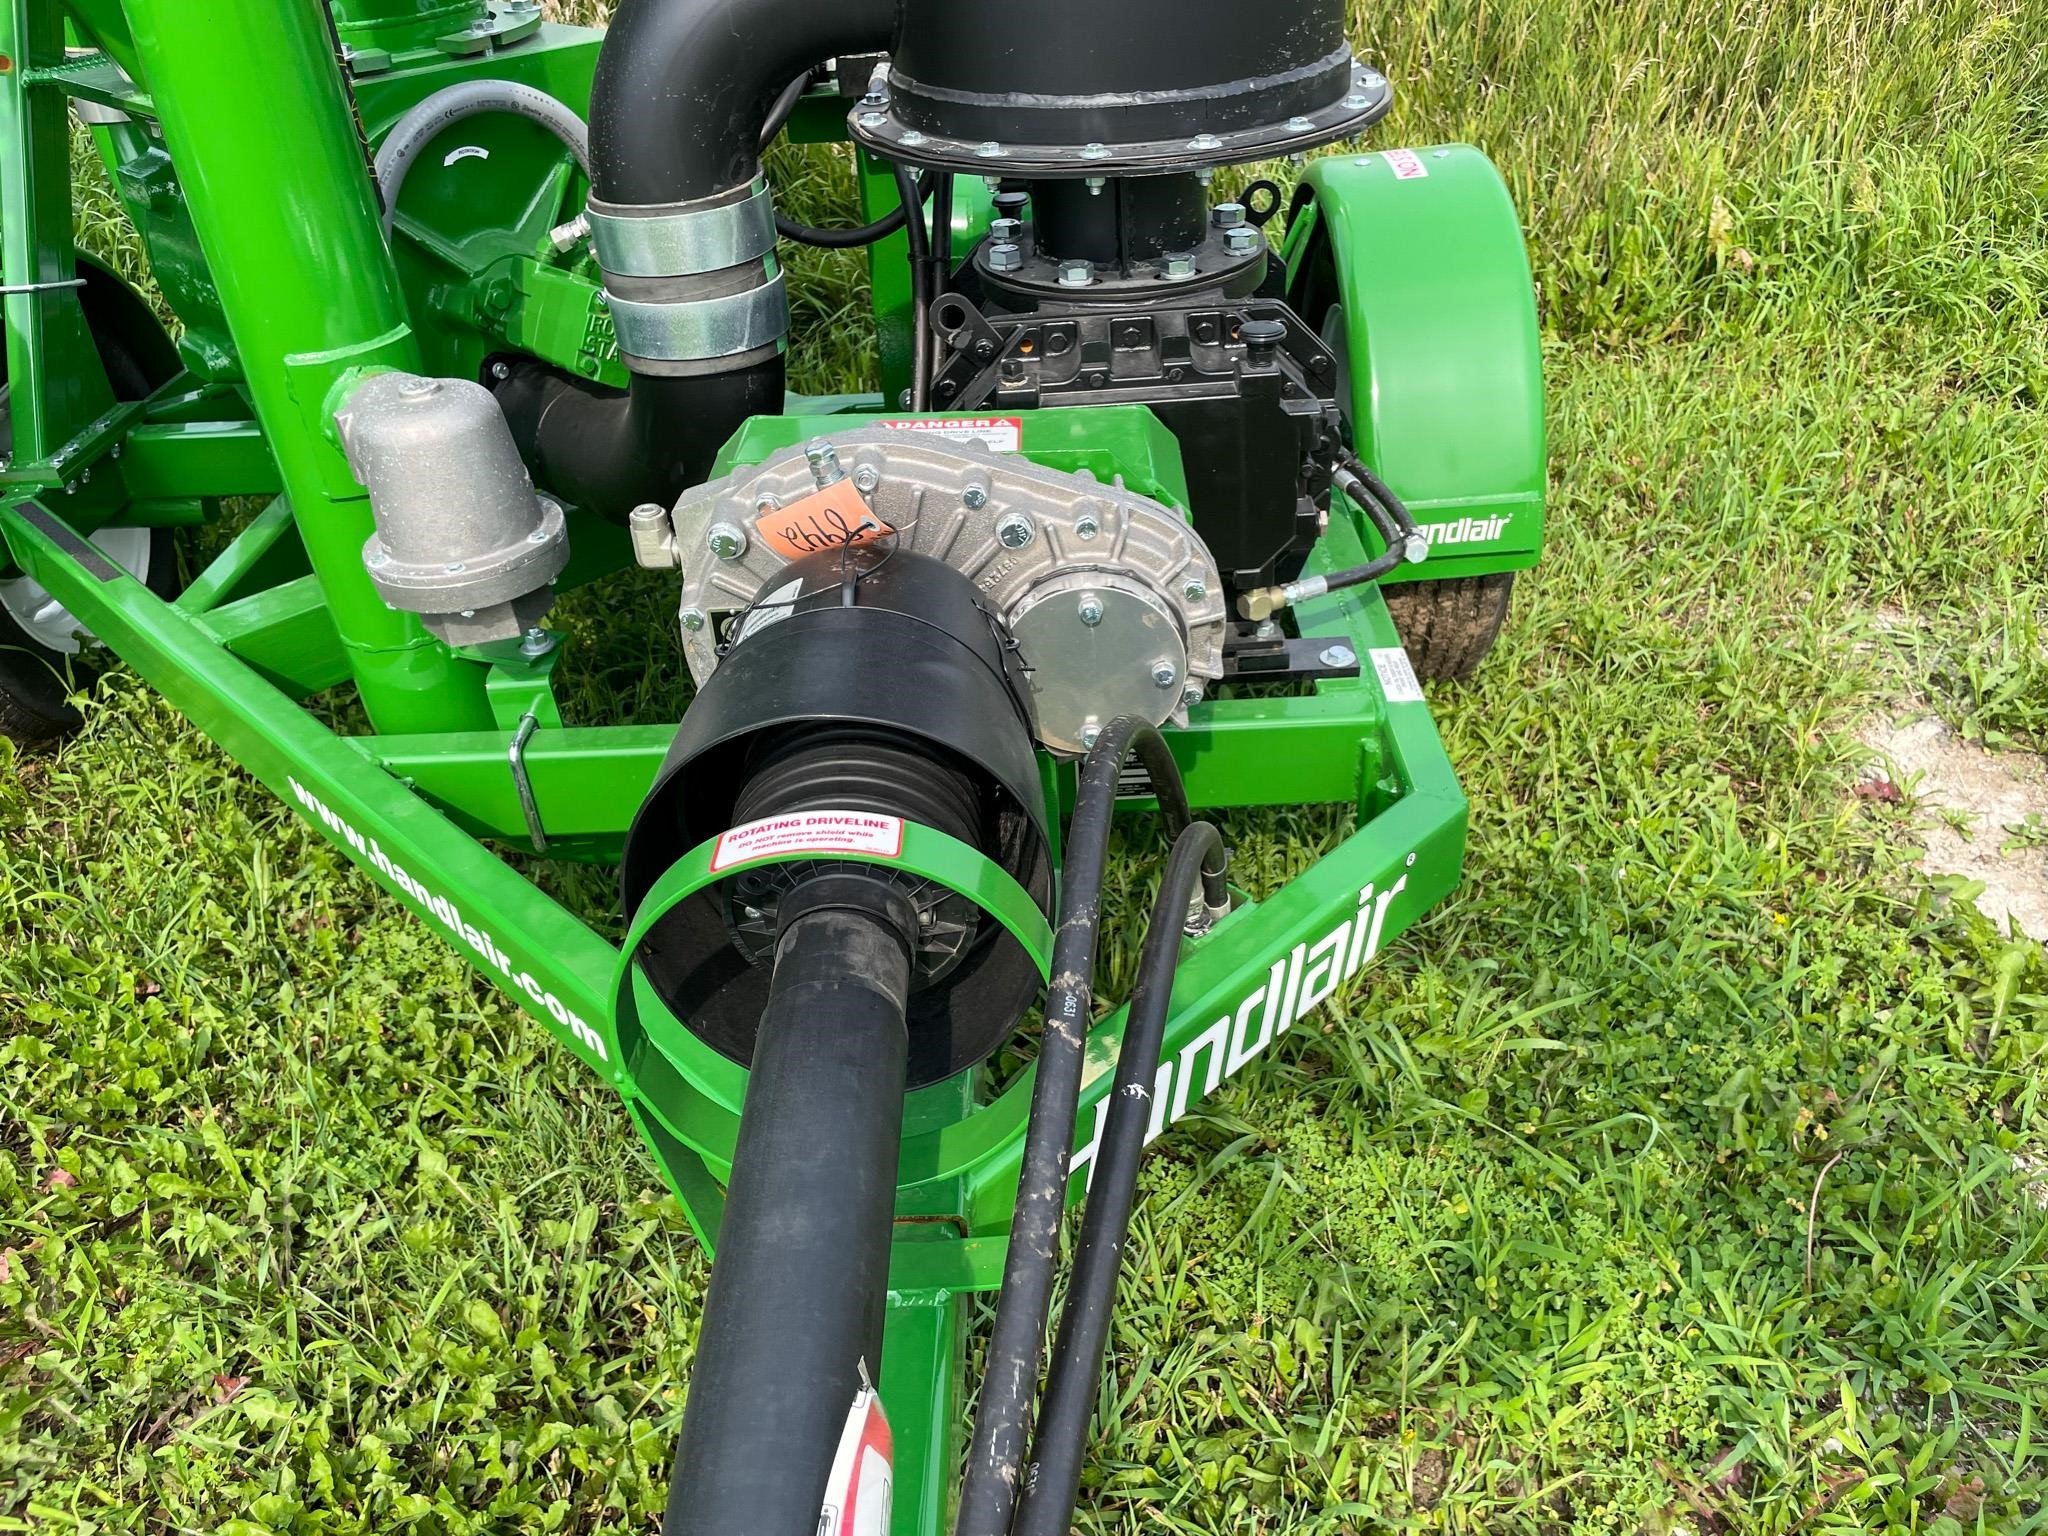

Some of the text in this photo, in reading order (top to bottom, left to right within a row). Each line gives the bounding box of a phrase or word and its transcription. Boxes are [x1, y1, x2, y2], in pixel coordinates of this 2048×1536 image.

[896, 419, 990, 430] DANGER
[1396, 513, 1513, 545] andlair
[728, 817, 890, 843] ROTATING DRIVELINE
[738, 840, 752, 849] DO
[755, 835, 775, 844] NOT
[777, 831, 813, 839] remove
[848, 830, 874, 838] while
[752, 839, 792, 851] machine
[287, 775, 609, 1062] www.handlair.com
[1063, 995, 1077, 1017] 0631
